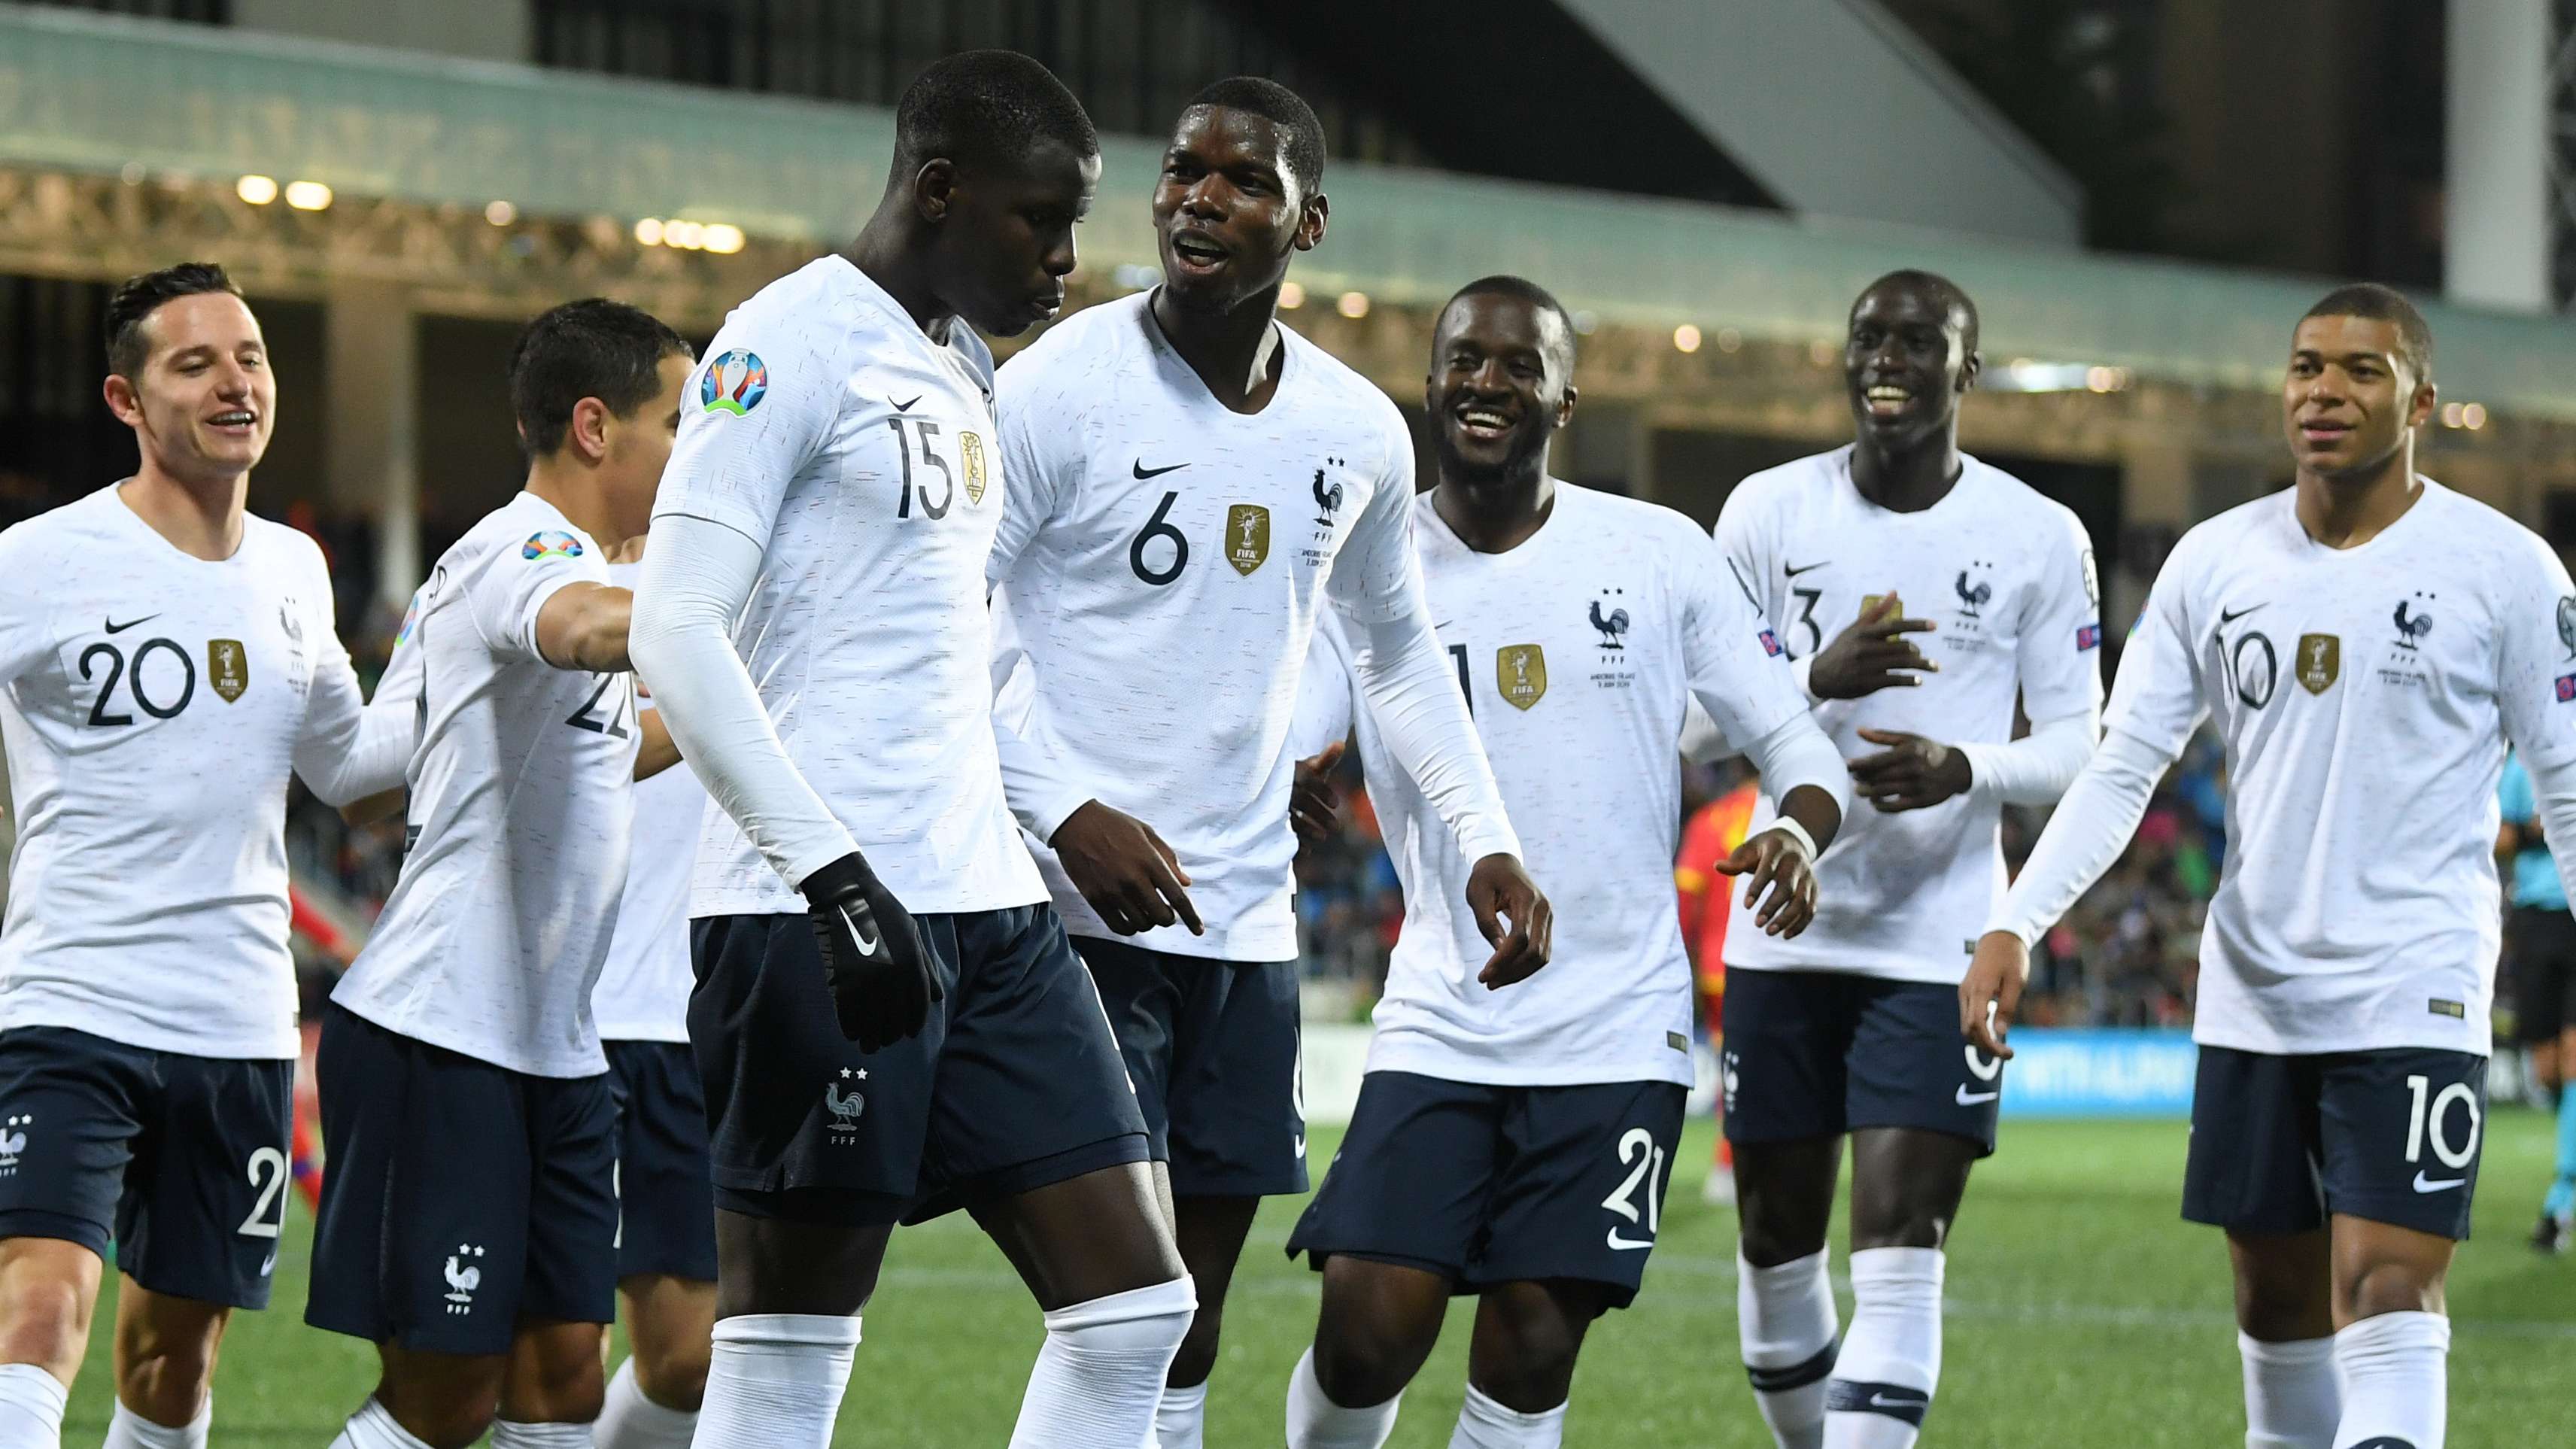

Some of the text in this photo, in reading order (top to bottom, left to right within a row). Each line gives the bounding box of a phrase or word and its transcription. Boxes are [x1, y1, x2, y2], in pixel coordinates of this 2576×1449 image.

[887, 418, 953, 521] 15
[1129, 491, 1189, 586] 6
[1236, 548, 1256, 559] FIFA
[1785, 587, 1821, 662] 3
[2215, 630, 2277, 710] 10
[78, 636, 196, 726] 20
[831, 1135, 856, 1146] FFF
[2404, 1074, 2480, 1168] 10
[236, 1146, 293, 1238] 2
[1600, 1127, 1665, 1234] 21
